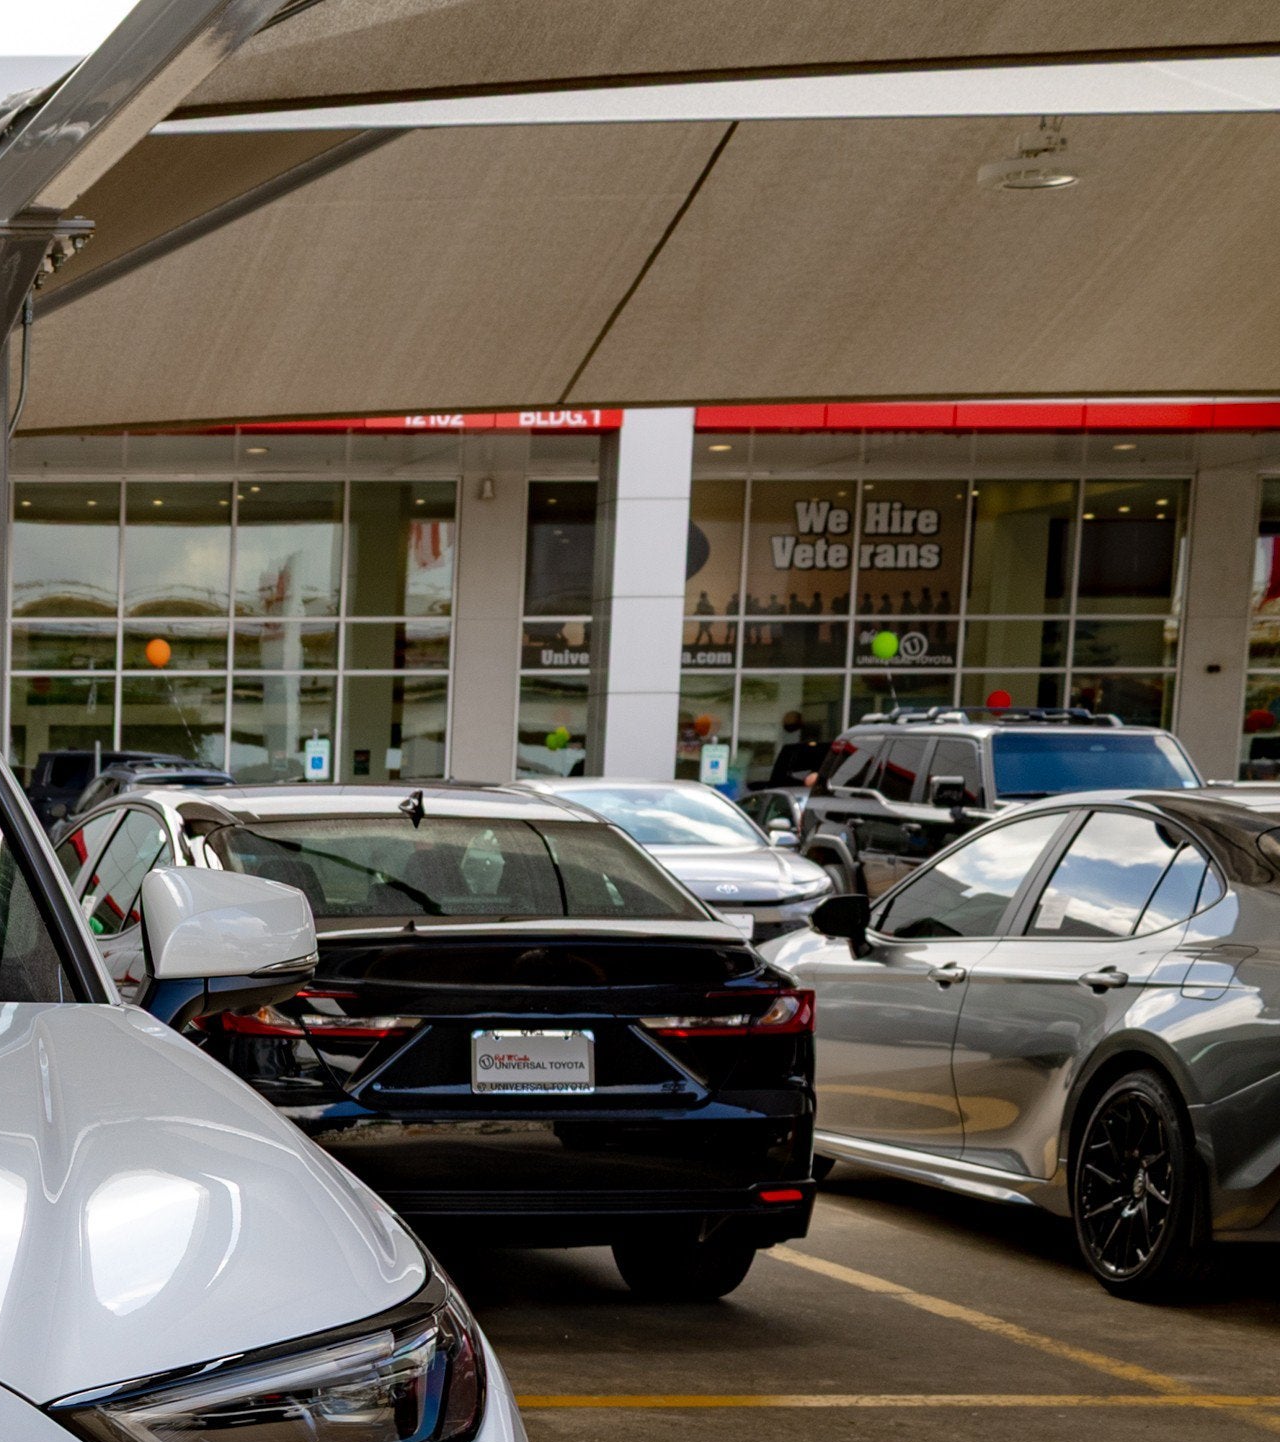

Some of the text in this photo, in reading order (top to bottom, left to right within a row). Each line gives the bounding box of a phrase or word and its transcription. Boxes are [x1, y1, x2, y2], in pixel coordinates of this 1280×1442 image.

[795, 501, 938, 534] We Hire
[771, 536, 940, 569] Veterans
[494, 1061, 585, 1070] UNIVERSAL TOYOTA
